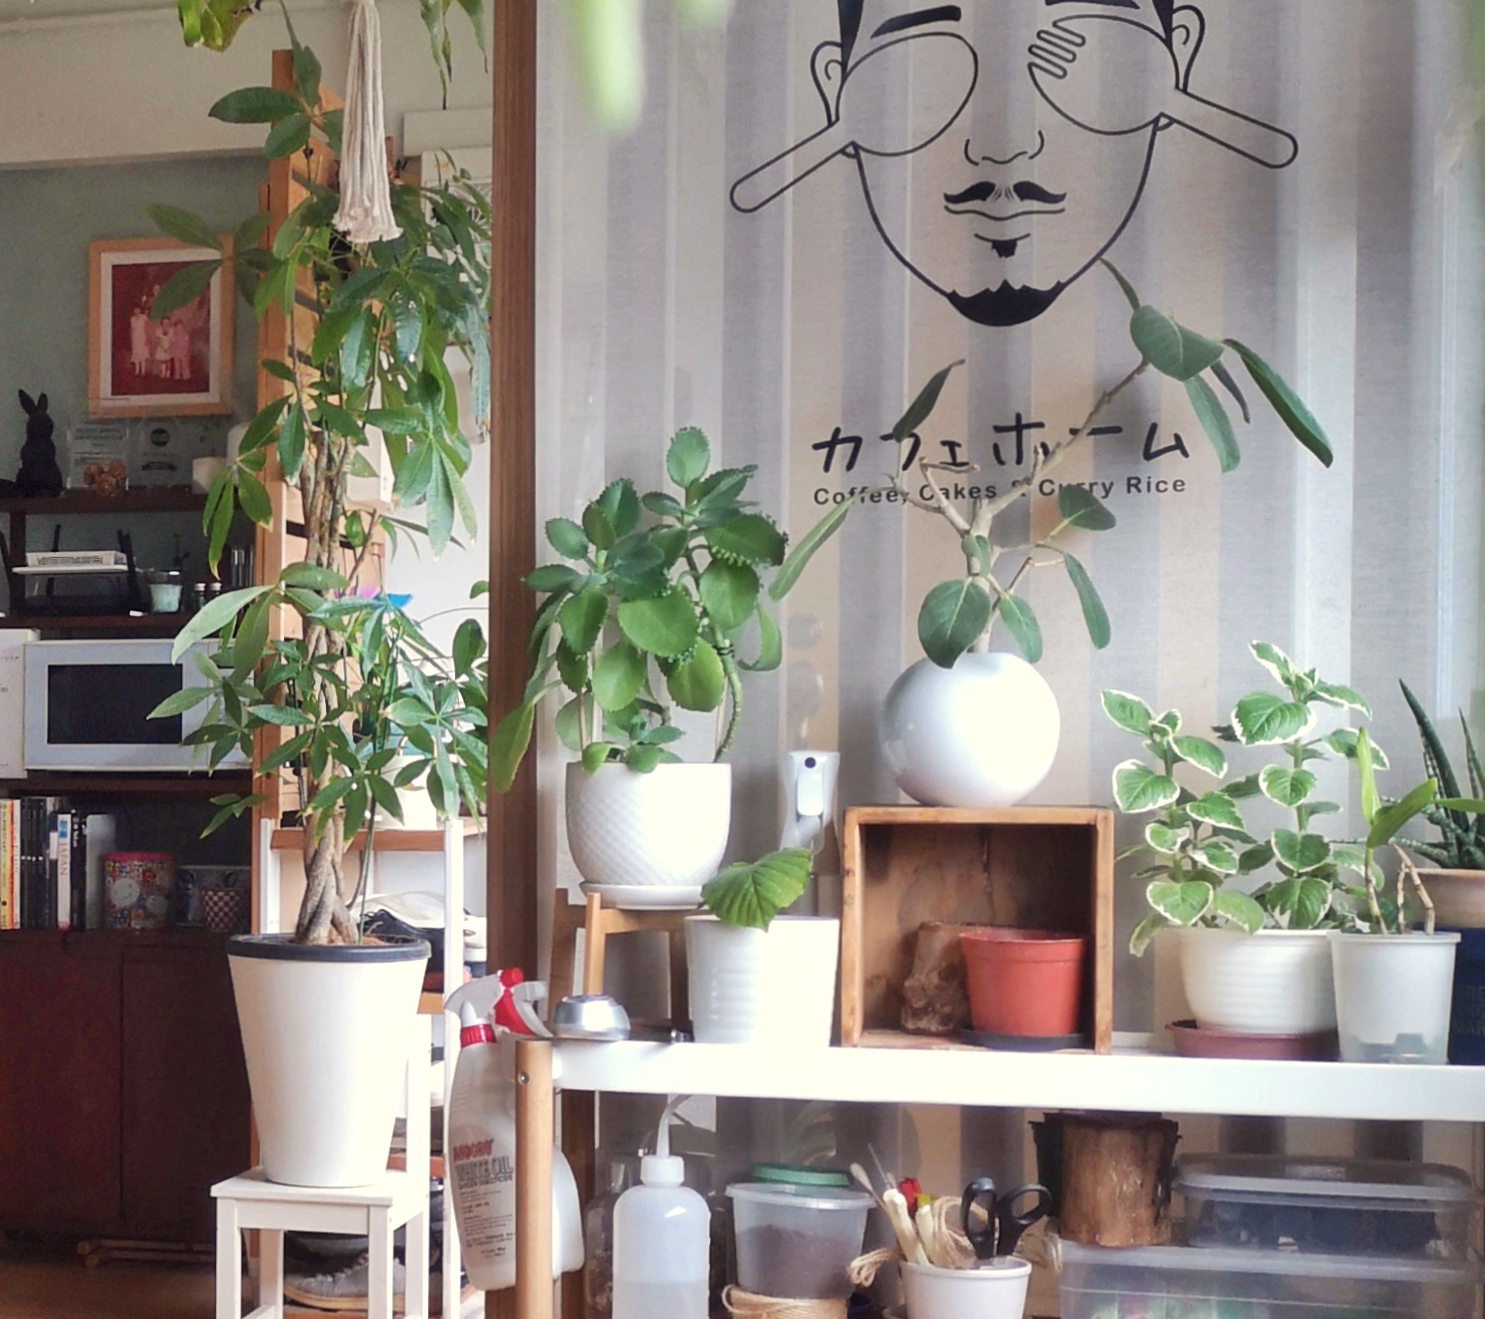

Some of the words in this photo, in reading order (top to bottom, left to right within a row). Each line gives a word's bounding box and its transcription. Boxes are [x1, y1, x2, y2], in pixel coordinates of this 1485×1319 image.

[812, 412, 1190, 473] カフェホーム
[919, 483, 997, 501] Cakes
[1038, 478, 1115, 500] Cry
[1126, 476, 1186, 494] Rice
